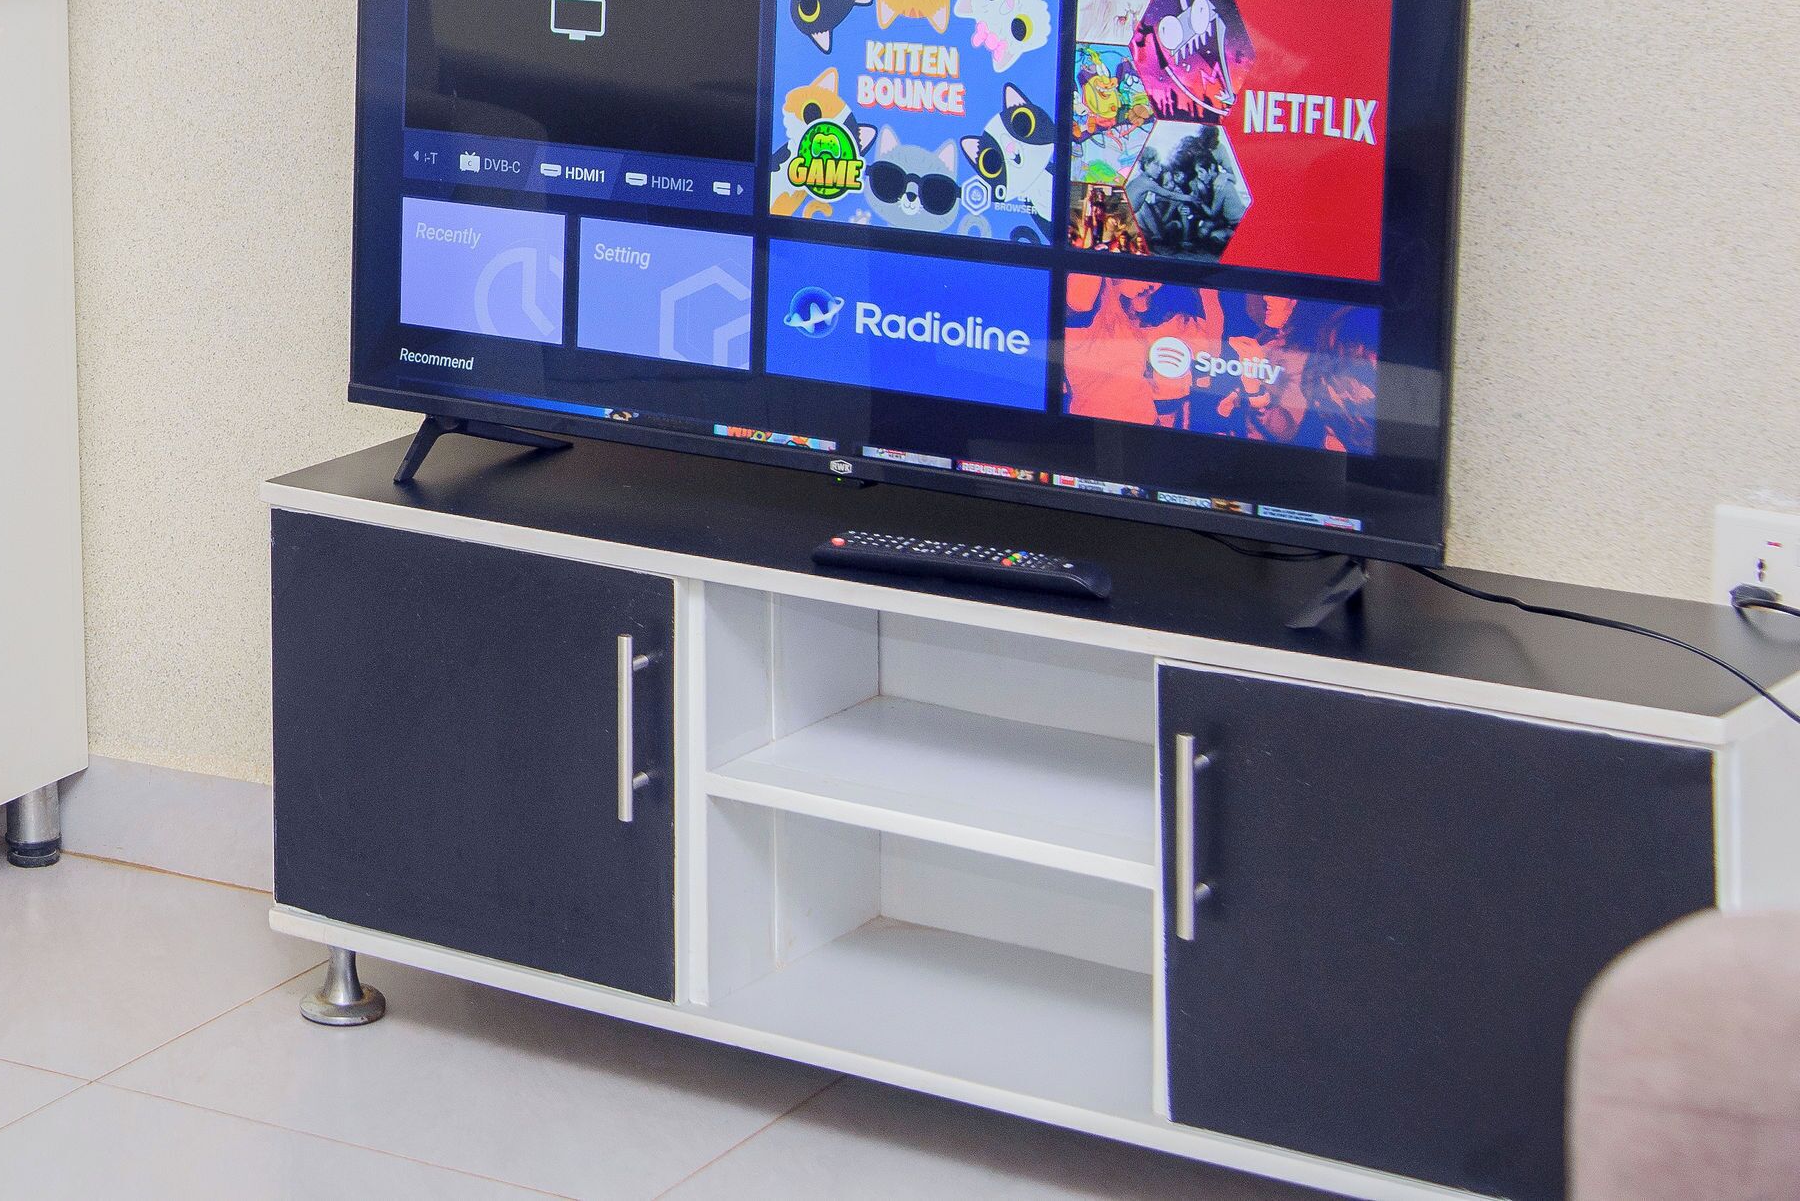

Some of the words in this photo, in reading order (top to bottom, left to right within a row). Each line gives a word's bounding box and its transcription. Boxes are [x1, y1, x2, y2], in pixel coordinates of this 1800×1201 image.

[865, 39, 960, 78] KITTEN
[857, 74, 966, 117] BOUNCE
[1243, 89, 1377, 146] NETFLIX
[483, 157, 521, 174] DVB-C
[564, 166, 606, 184] HDMI1
[650, 175, 694, 193] HDMI2
[787, 157, 864, 189] GAME
[994, 202, 1038, 215] BROWSER
[415, 222, 482, 249] Recently
[593, 242, 652, 270] Setting
[855, 301, 1031, 355] Radioline
[399, 347, 475, 371] Recommend
[1194, 350, 1283, 385] Spotify
